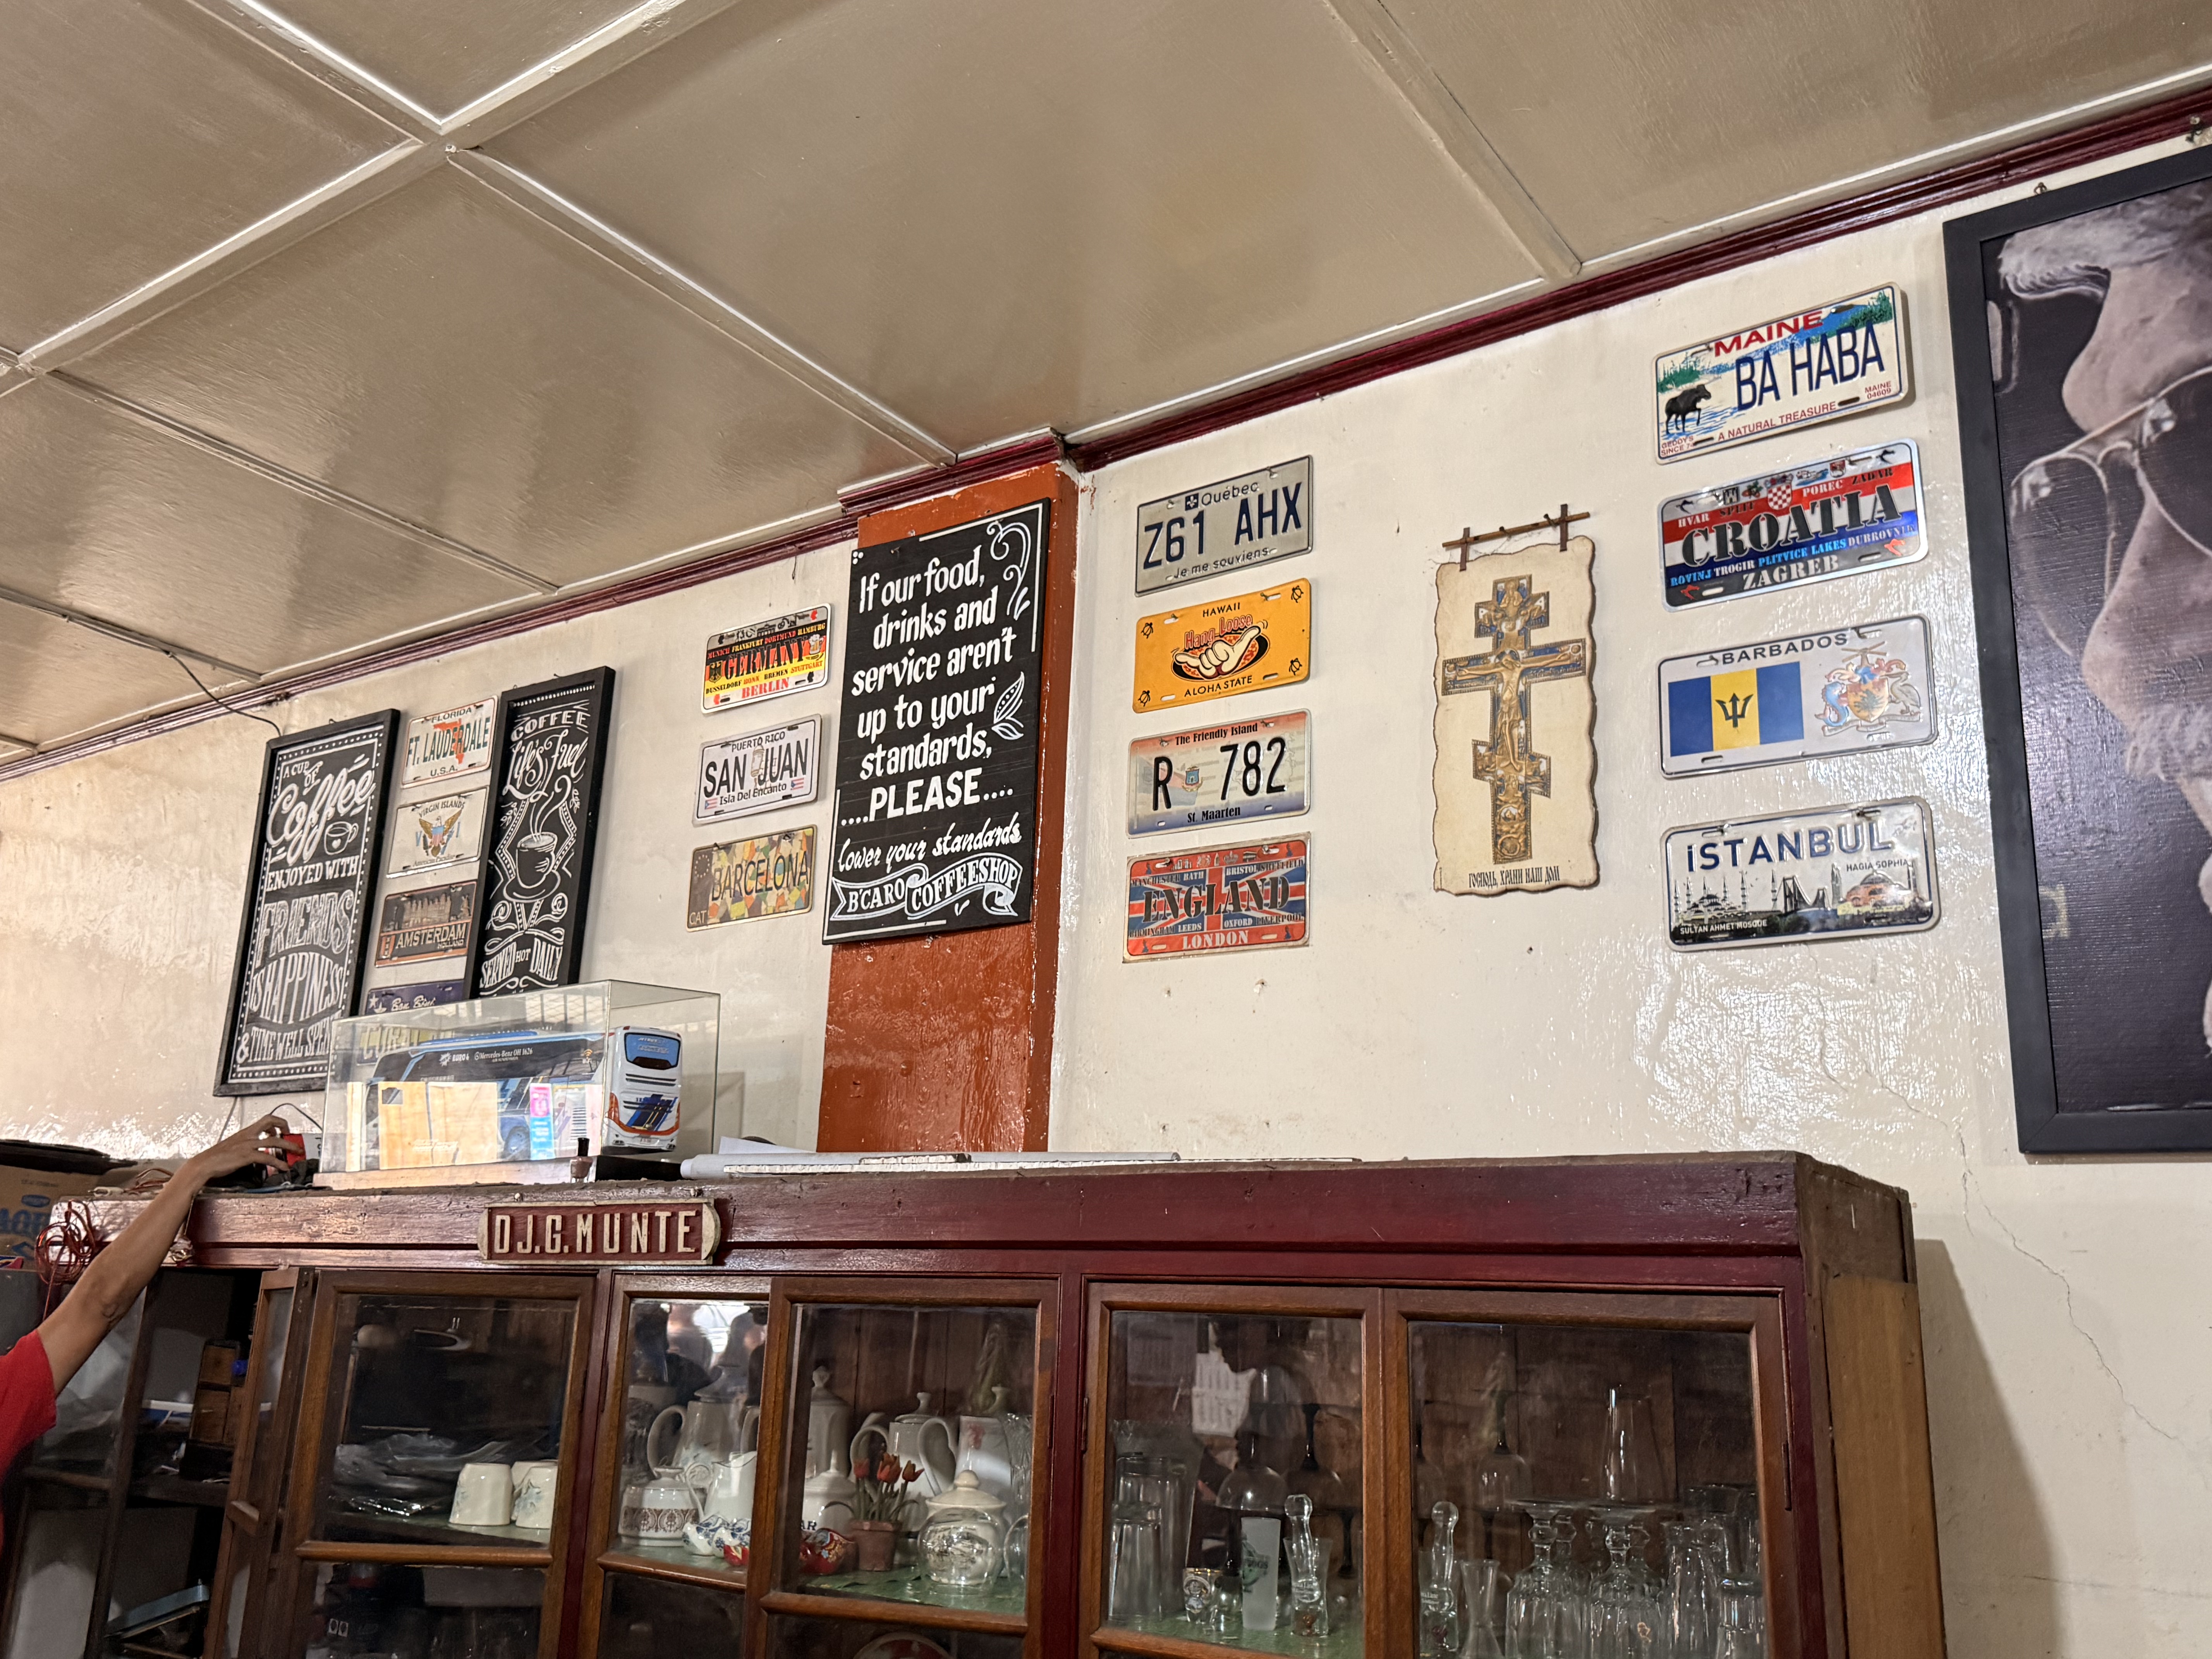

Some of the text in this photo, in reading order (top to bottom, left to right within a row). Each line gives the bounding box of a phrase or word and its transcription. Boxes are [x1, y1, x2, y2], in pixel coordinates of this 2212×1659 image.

[1714, 311, 1823, 357] MAINE
[1735, 320, 1885, 411] BA HABA
[1865, 381, 1891, 393] MAINE
[1867, 388, 1891, 399] 04609
[1718, 401, 1836, 441] A NATURAL TREASURE
[1661, 445, 1684, 456] SINCE
[1202, 481, 1259, 506] Québec
[1678, 514, 1710, 528] HVAR
[1719, 502, 1755, 517] SPLIT
[1851, 467, 1894, 485] ZADAR
[1144, 482, 1302, 570] Z61 AHX
[1681, 484, 1902, 567] CROATIA
[1174, 546, 1269, 579] Je me souviens
[1670, 524, 1915, 587] ROVINJ TROGIR PLITVICE LAKES DUBROVNIK
[1743, 554, 1839, 591] ZAGREB
[859, 544, 984, 613] If our food,
[873, 585, 998, 650] drinks and
[1202, 602, 1241, 618] HAWAII
[708, 622, 826, 659] MUNICH FRANKFURT DORTMUND HAMBURG
[1184, 614, 1253, 650] Hang Loose
[1722, 632, 1848, 665] BARBADOS
[724, 635, 808, 680] GERMANY
[852, 647, 941, 696] service
[706, 660, 823, 694] DUSSELDORF BONN BREMEN STUTTGART
[741, 677, 790, 699] BERLIN
[1184, 675, 1252, 697] ALOHA STATE
[431, 707, 472, 723] FLORIDA
[510, 710, 591, 742] COFFEE
[857, 683, 995, 744] up to your
[405, 717, 491, 768] FT. LAUDERDALE
[732, 731, 785, 752] PUERTO RICO
[860, 722, 992, 780] standards,
[1175, 723, 1258, 746] The Friendly Island
[283, 761, 310, 779] A CUP
[430, 765, 458, 777] U.S.A.
[541, 729, 589, 792] Fuel
[704, 738, 809, 798] SAN JUAN
[1152, 737, 1286, 811] R 782
[304, 769, 318, 788] OF
[720, 783, 787, 805] Isla Del Encanto
[266, 767, 375, 866] Coffee
[419, 800, 465, 817] VIRGIN ISLANDS
[1202, 806, 1241, 821] Maarten
[886, 839, 927, 874] your
[933, 812, 1022, 857] standards
[266, 855, 360, 891] ENJOYED WITH
[712, 850, 809, 902] BARCELONA
[1183, 871, 1204, 881] BATH
[1226, 865, 1258, 876] BRISTOL
[1846, 859, 1908, 872] HAGIA SOPHIA
[1142, 876, 1290, 923] ENGLAND
[255, 889, 354, 969] FRIENDS
[689, 910, 707, 925] CAT
[1178, 923, 1202, 933] LEEDS
[1224, 918, 1253, 928] OXFORD
[1256, 912, 1304, 926] LIVERPOOL
[1680, 919, 1768, 934] SULTAN AHMET MOSQUE
[395, 923, 466, 949] AMSTERDAM
[437, 939, 464, 949] HOLLAND
[1182, 930, 1249, 950] LONDON
[479, 938, 563, 988] SERVED HOT DAILY
[249, 951, 343, 1024] IS HAPPINESS
[236, 1032, 250, 1064] &
[248, 1026, 275, 1063] TIME
[275, 1028, 304, 1060] WELL
[522, 1047, 533, 1056] 1626
